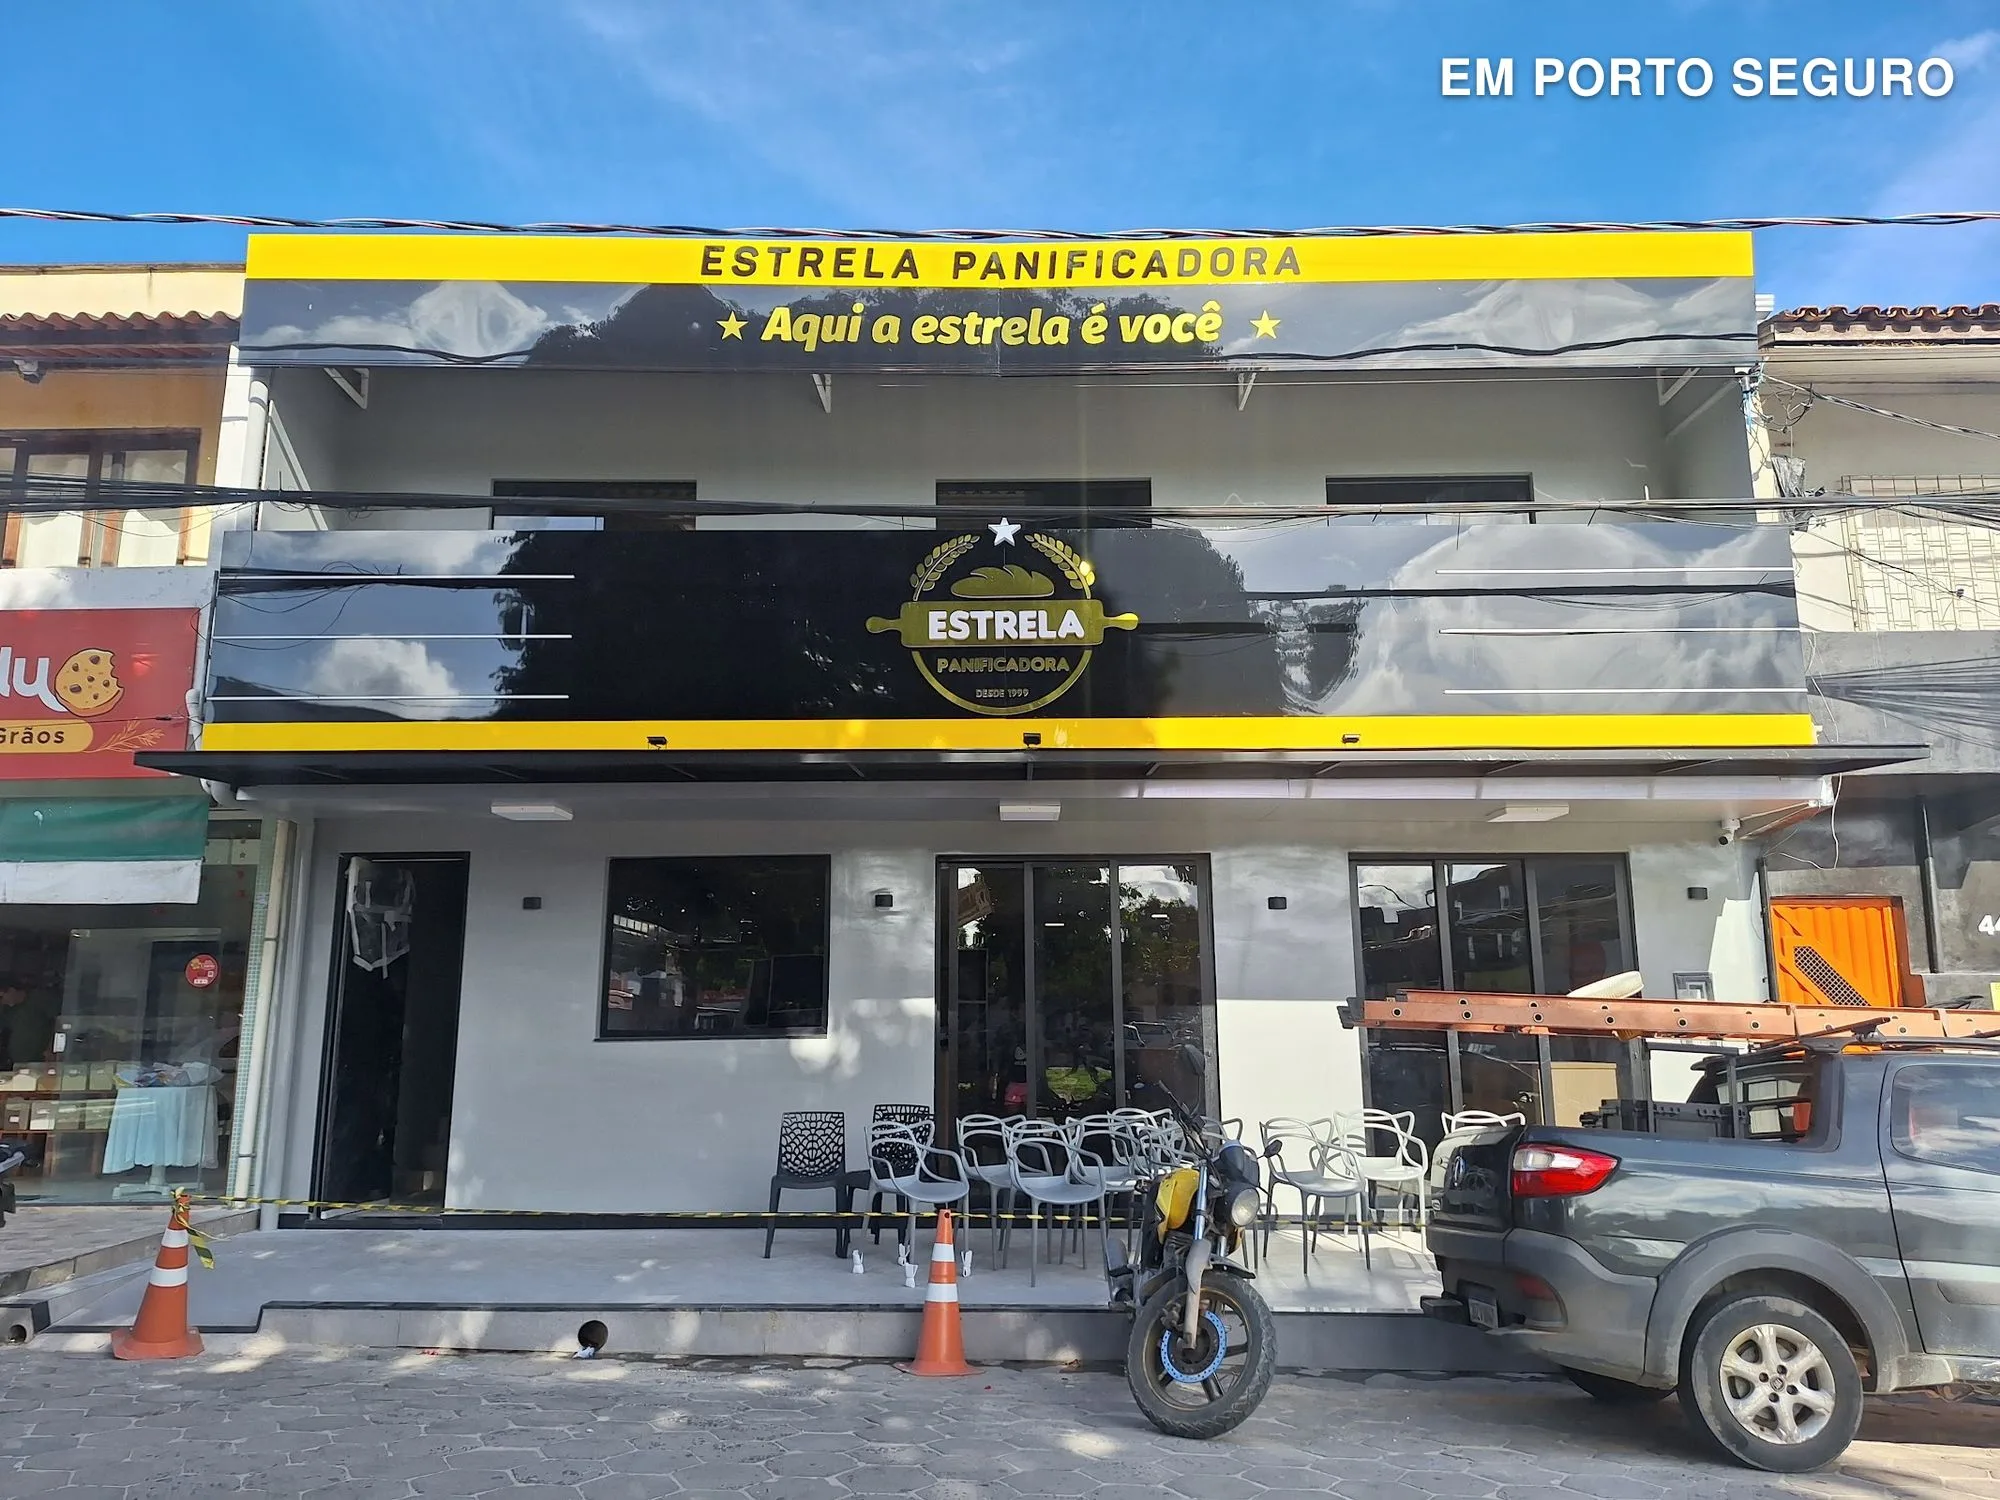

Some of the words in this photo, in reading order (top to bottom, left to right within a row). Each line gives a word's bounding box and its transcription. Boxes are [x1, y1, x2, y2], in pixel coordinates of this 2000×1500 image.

[701, 245, 920, 279] ESTRELA
[952, 246, 1301, 280] PANIFICADORA
[761, 303, 864, 352] Aqui
[871, 316, 900, 344] a
[911, 307, 1070, 346] estrela
[1081, 302, 1108, 345] é
[1119, 300, 1223, 343] você
[928, 609, 1085, 640] ESTRELA
[936, 657, 1070, 673] PANIFICADORA
[975, 688, 1005, 698] DESDE
[1007, 688, 1029, 698] 1999
